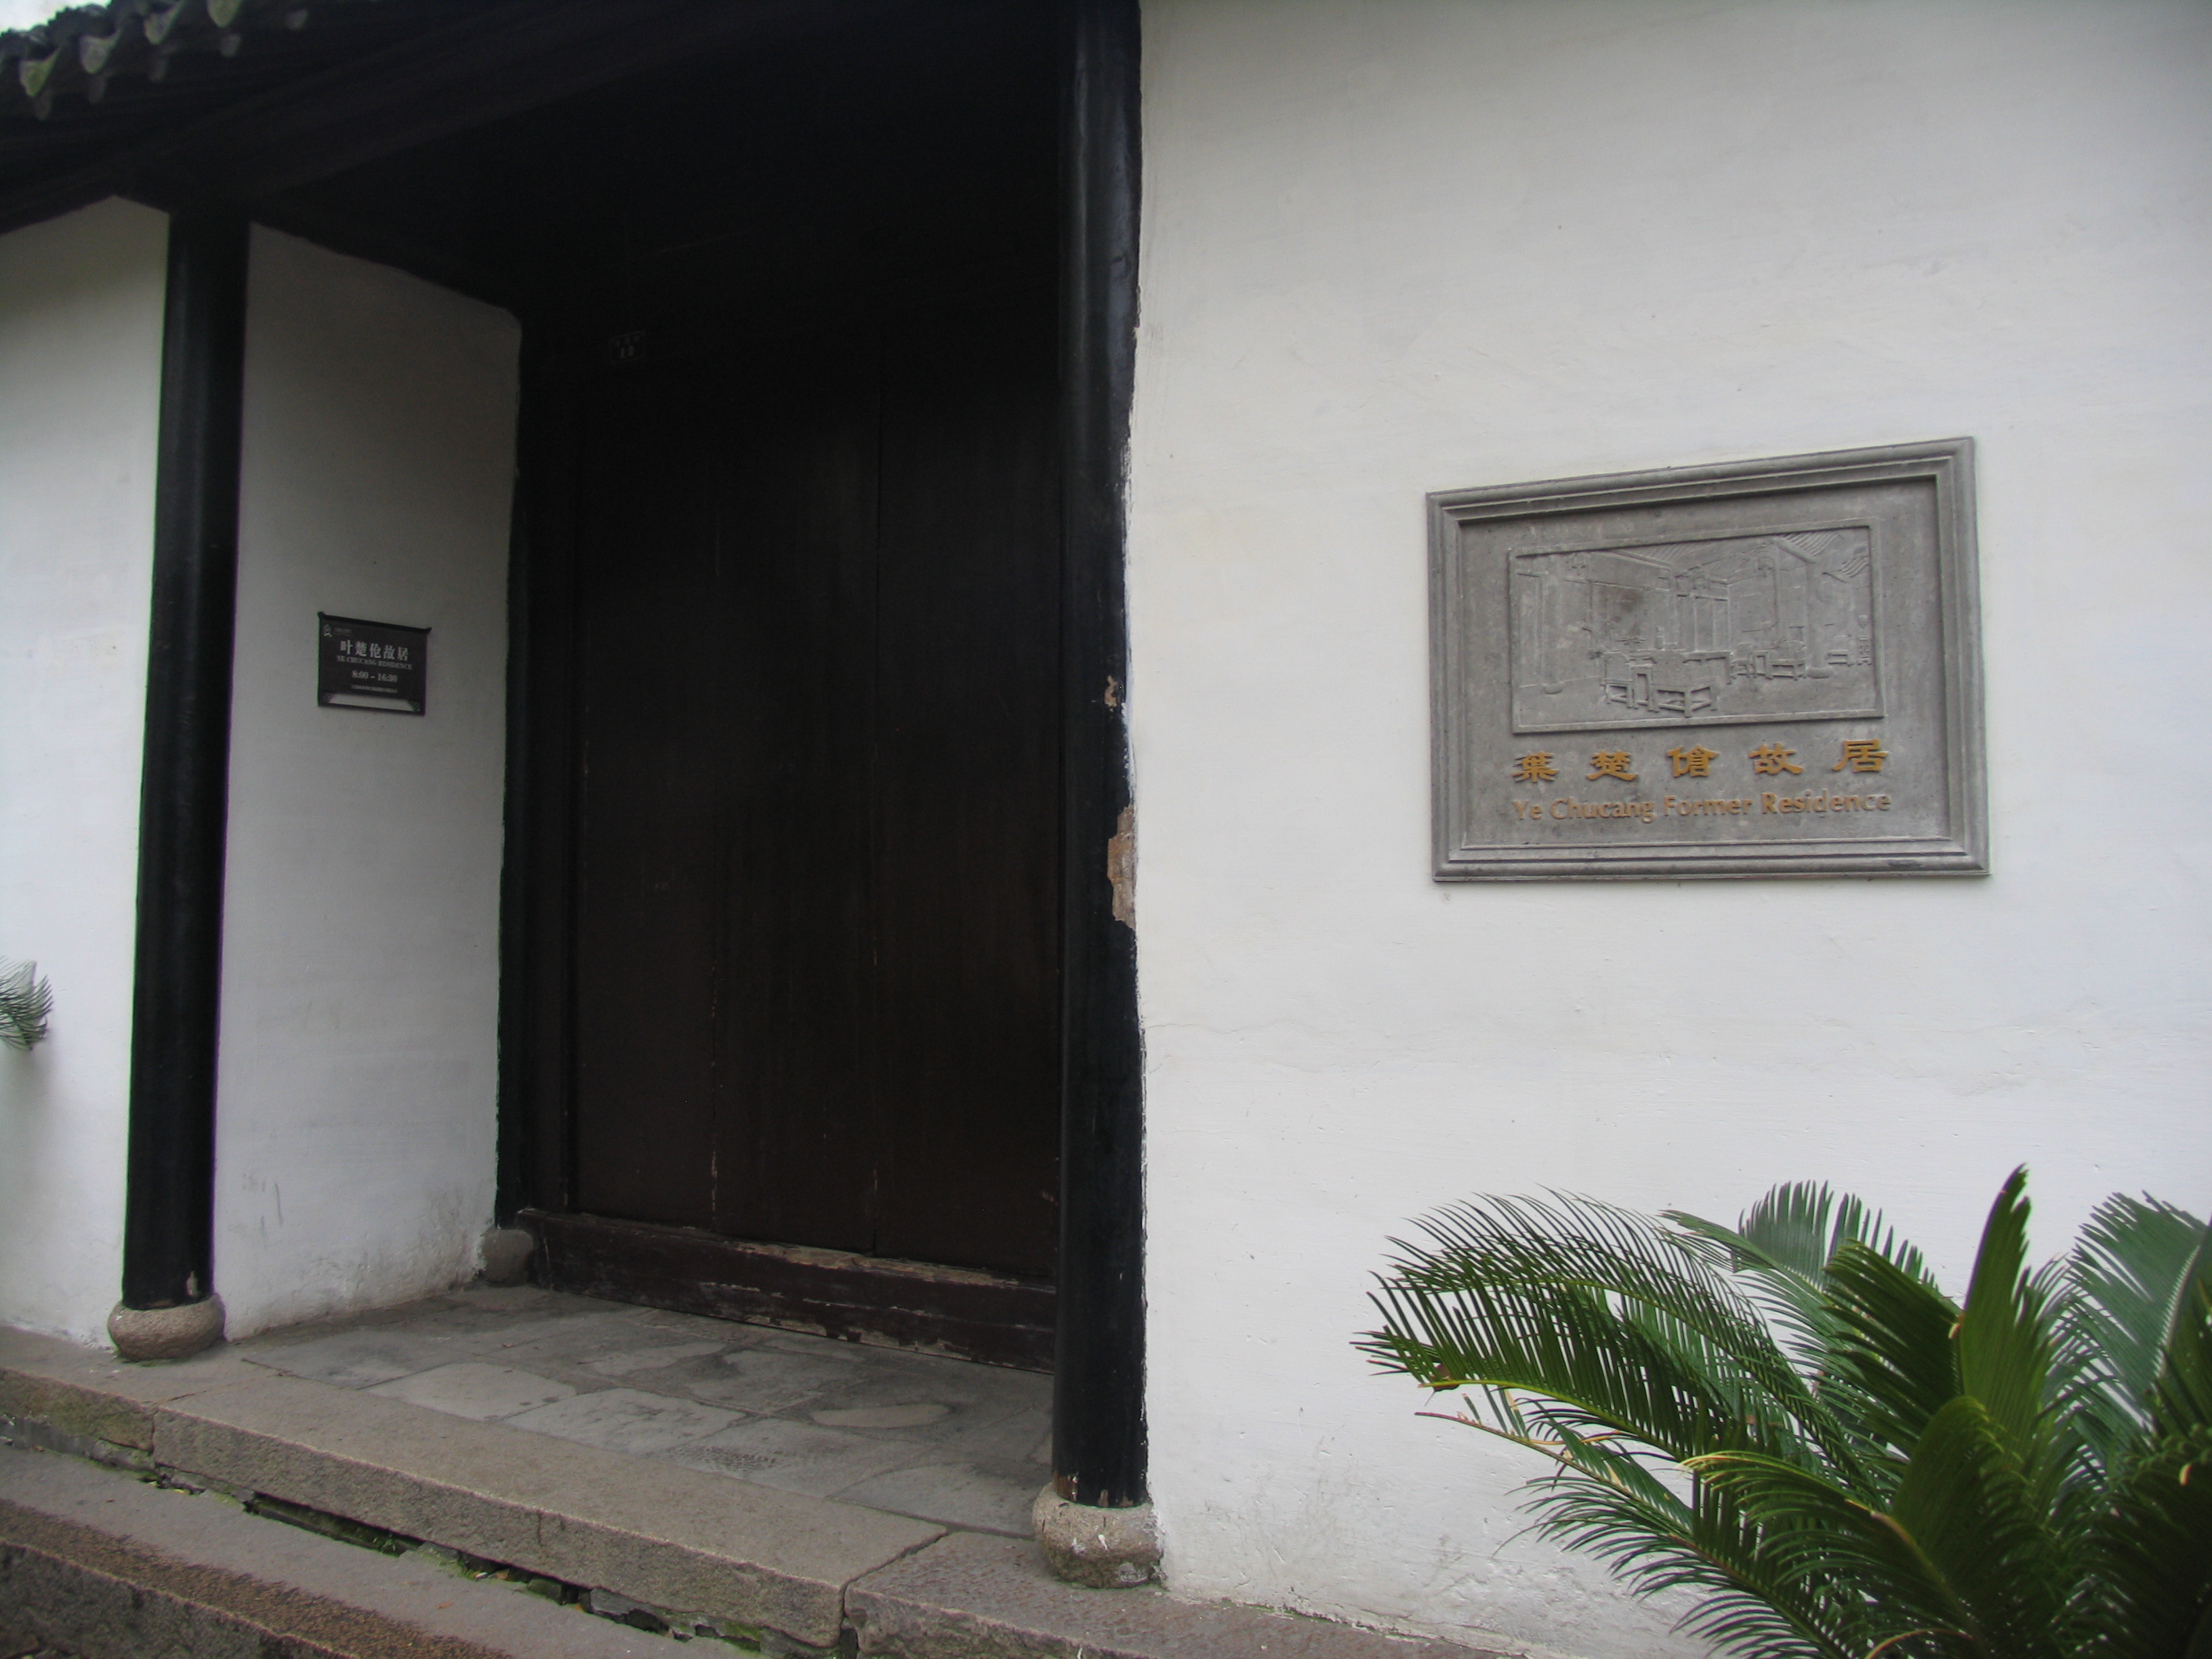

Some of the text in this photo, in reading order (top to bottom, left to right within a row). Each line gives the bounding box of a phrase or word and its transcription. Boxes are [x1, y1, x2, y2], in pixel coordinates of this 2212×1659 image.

[1512, 788, 1891, 824] Ye Chucang Former Residence
